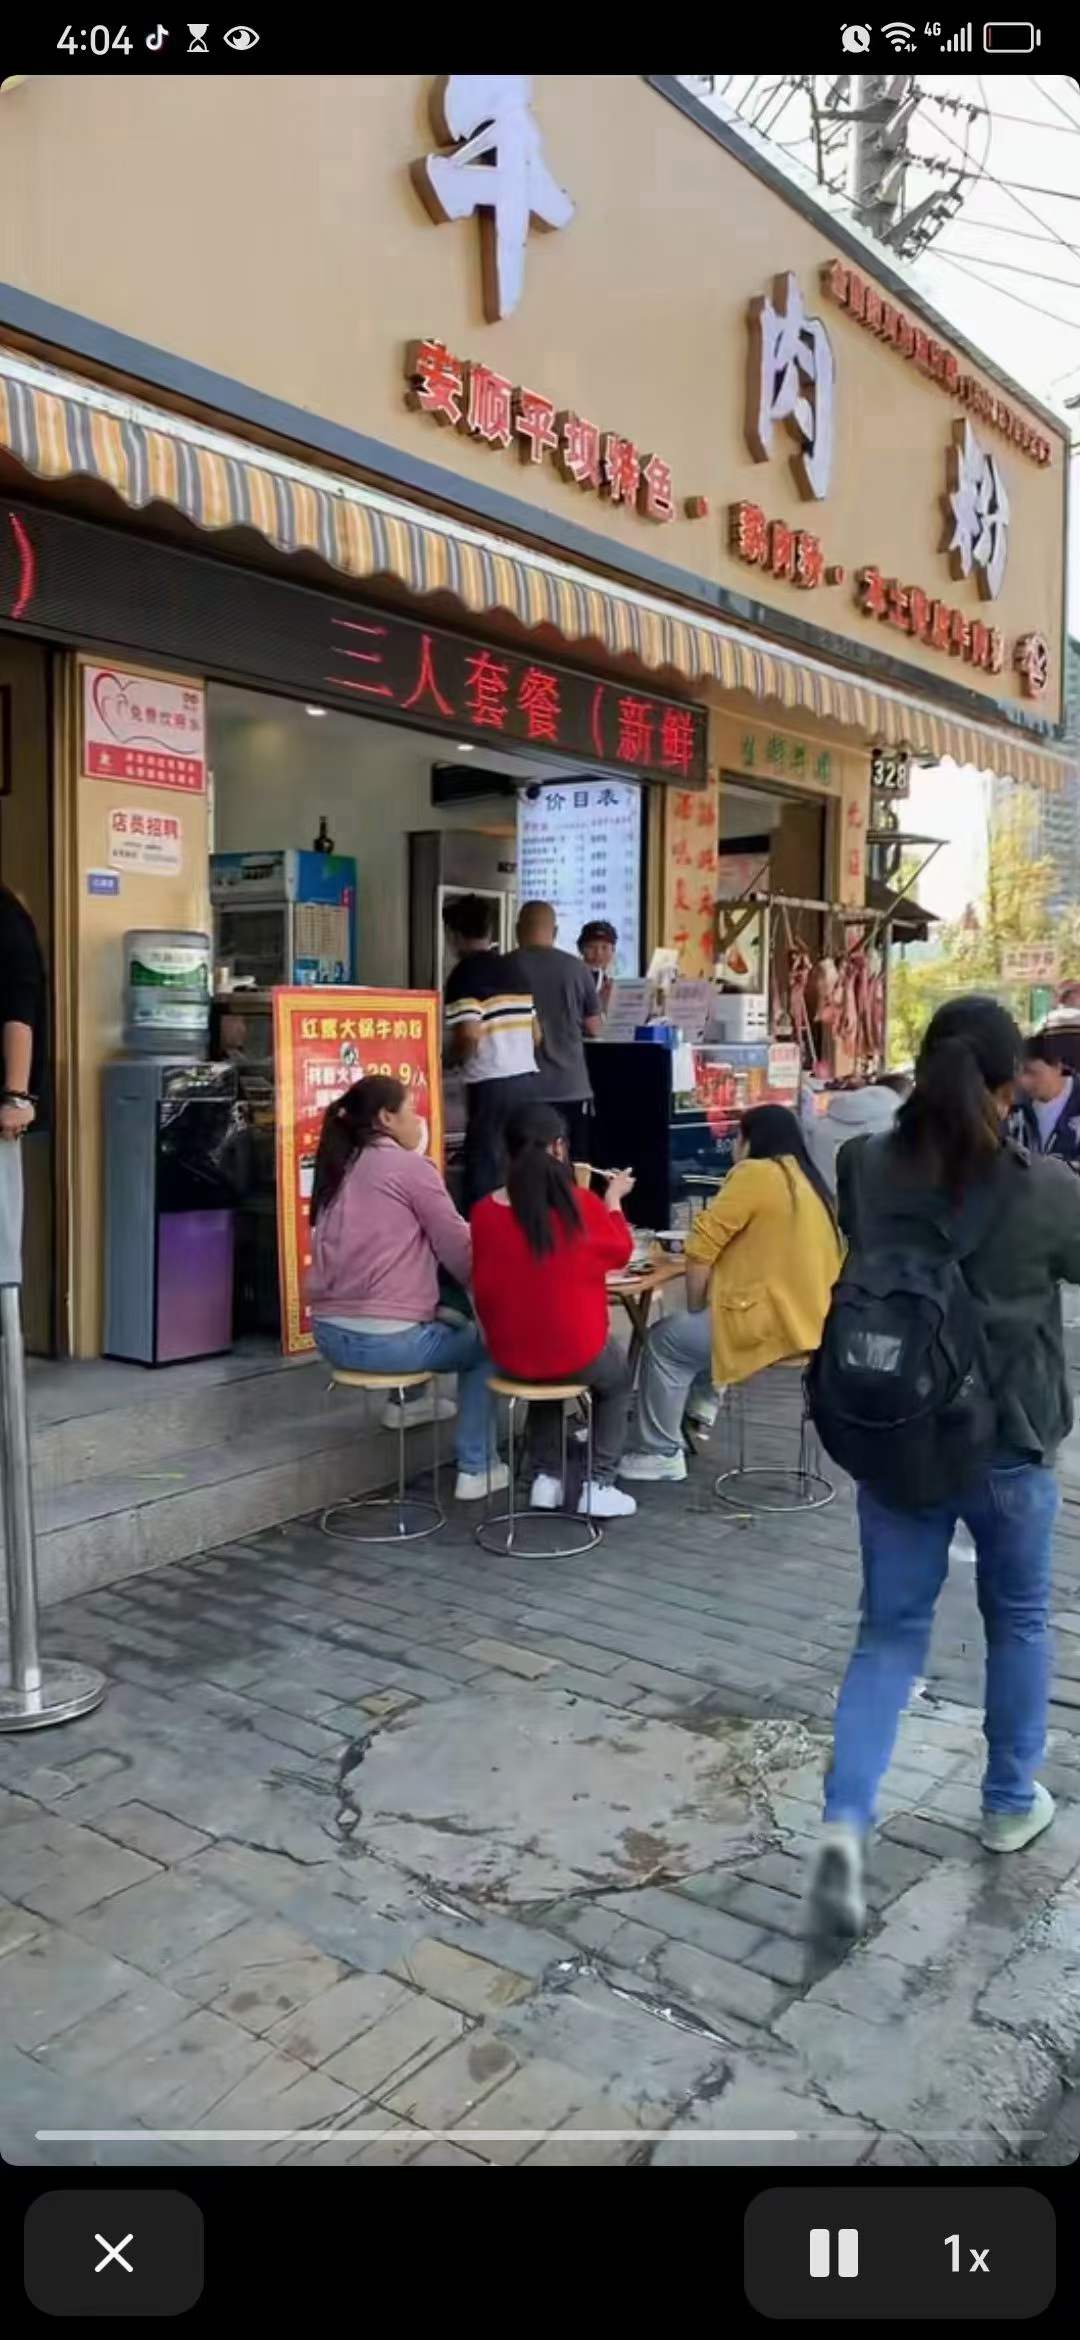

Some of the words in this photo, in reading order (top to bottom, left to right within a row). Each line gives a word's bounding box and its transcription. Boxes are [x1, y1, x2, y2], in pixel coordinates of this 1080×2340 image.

[874, 760, 907, 789] 328
[545, 788, 620, 811] 价目表
[112, 811, 179, 840] 店员招聘
